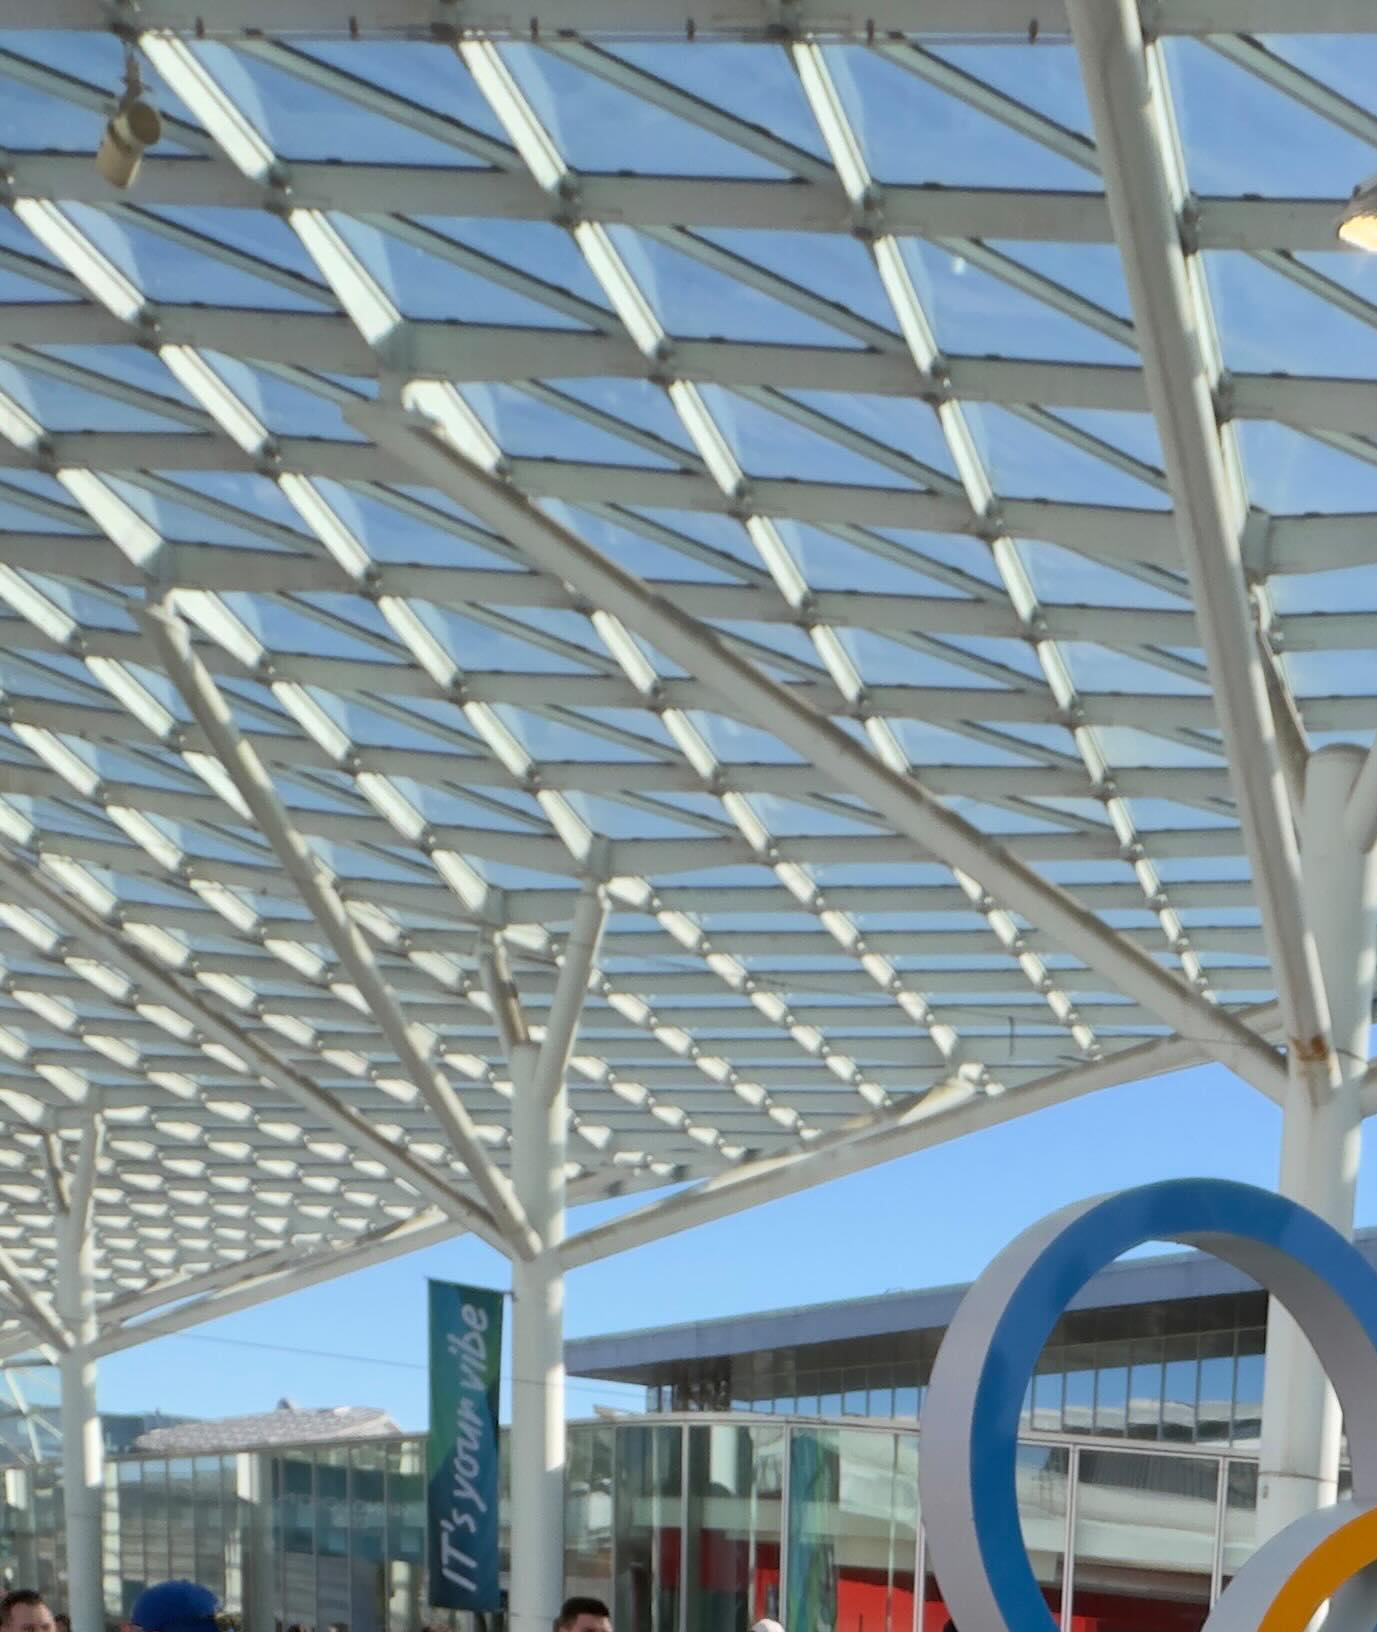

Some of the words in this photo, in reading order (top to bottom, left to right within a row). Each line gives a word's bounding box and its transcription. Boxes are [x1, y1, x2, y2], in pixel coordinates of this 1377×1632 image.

[447, 1303, 489, 1393] vibe
[453, 1397, 488, 1512] your
[440, 1507, 478, 1592] IT's
